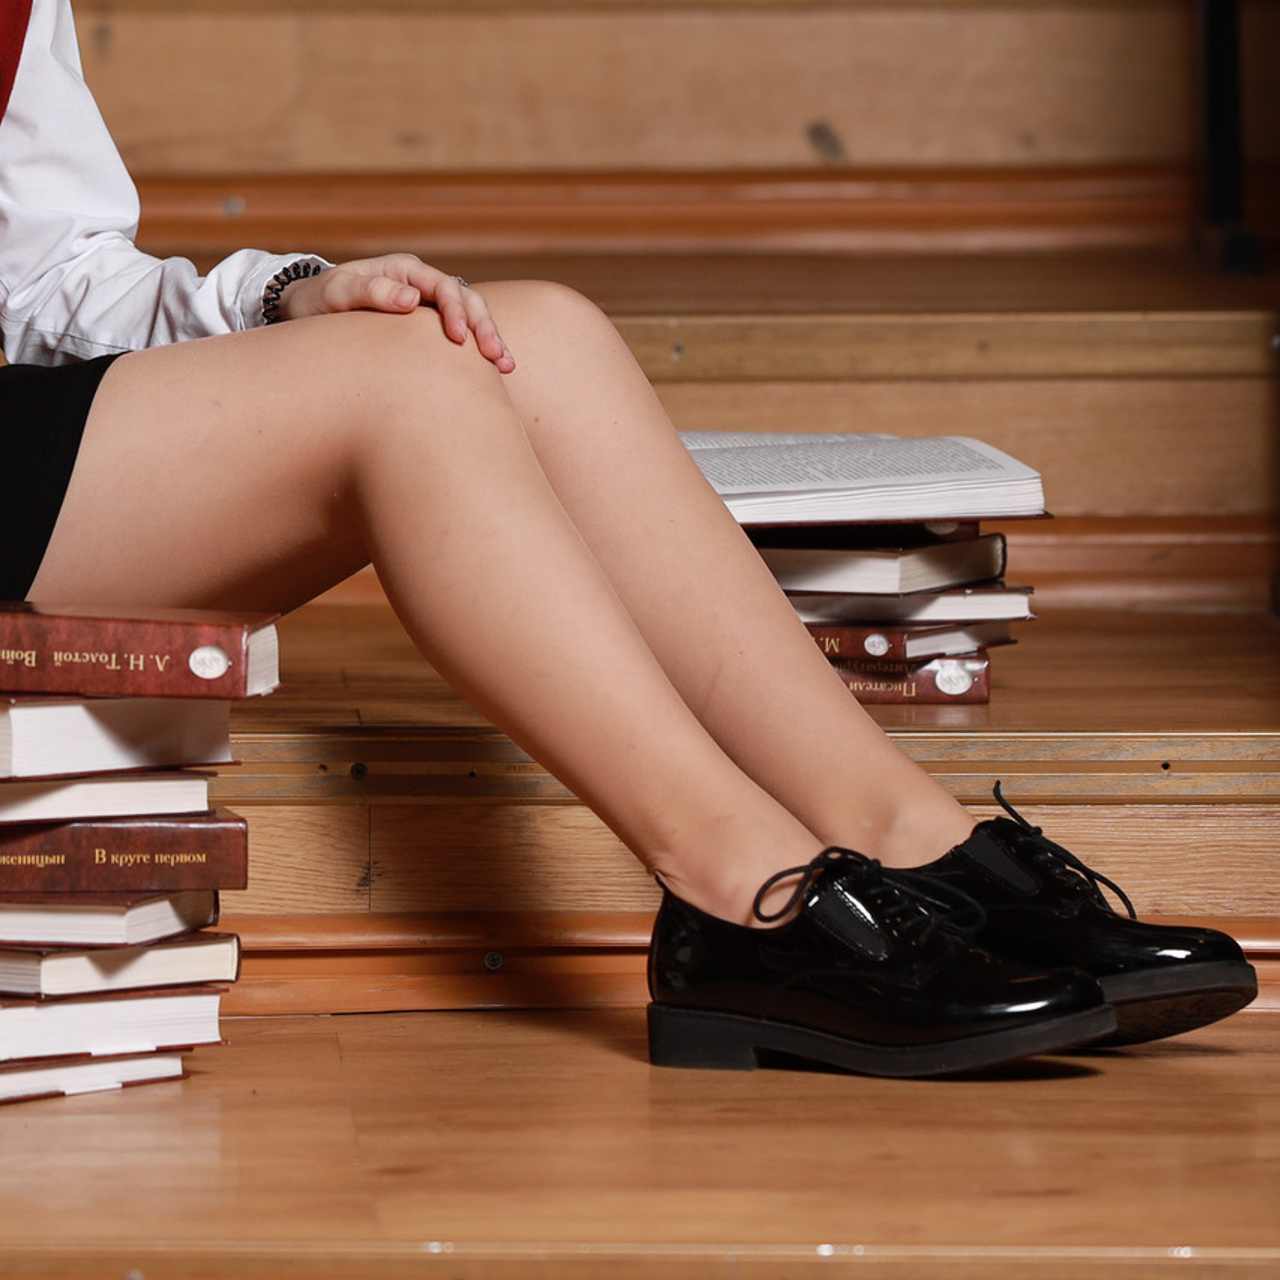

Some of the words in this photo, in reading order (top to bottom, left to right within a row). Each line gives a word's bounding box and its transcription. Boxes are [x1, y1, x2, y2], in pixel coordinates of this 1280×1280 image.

[820, 637, 840, 653] М.
[53, 651, 121, 670] Толстой
[124, 653, 144, 671] Н.
[849, 681, 916, 697] Писатели
[94, 848, 107, 864] В
[110, 853, 150, 867] круге
[154, 853, 207, 867] первом
